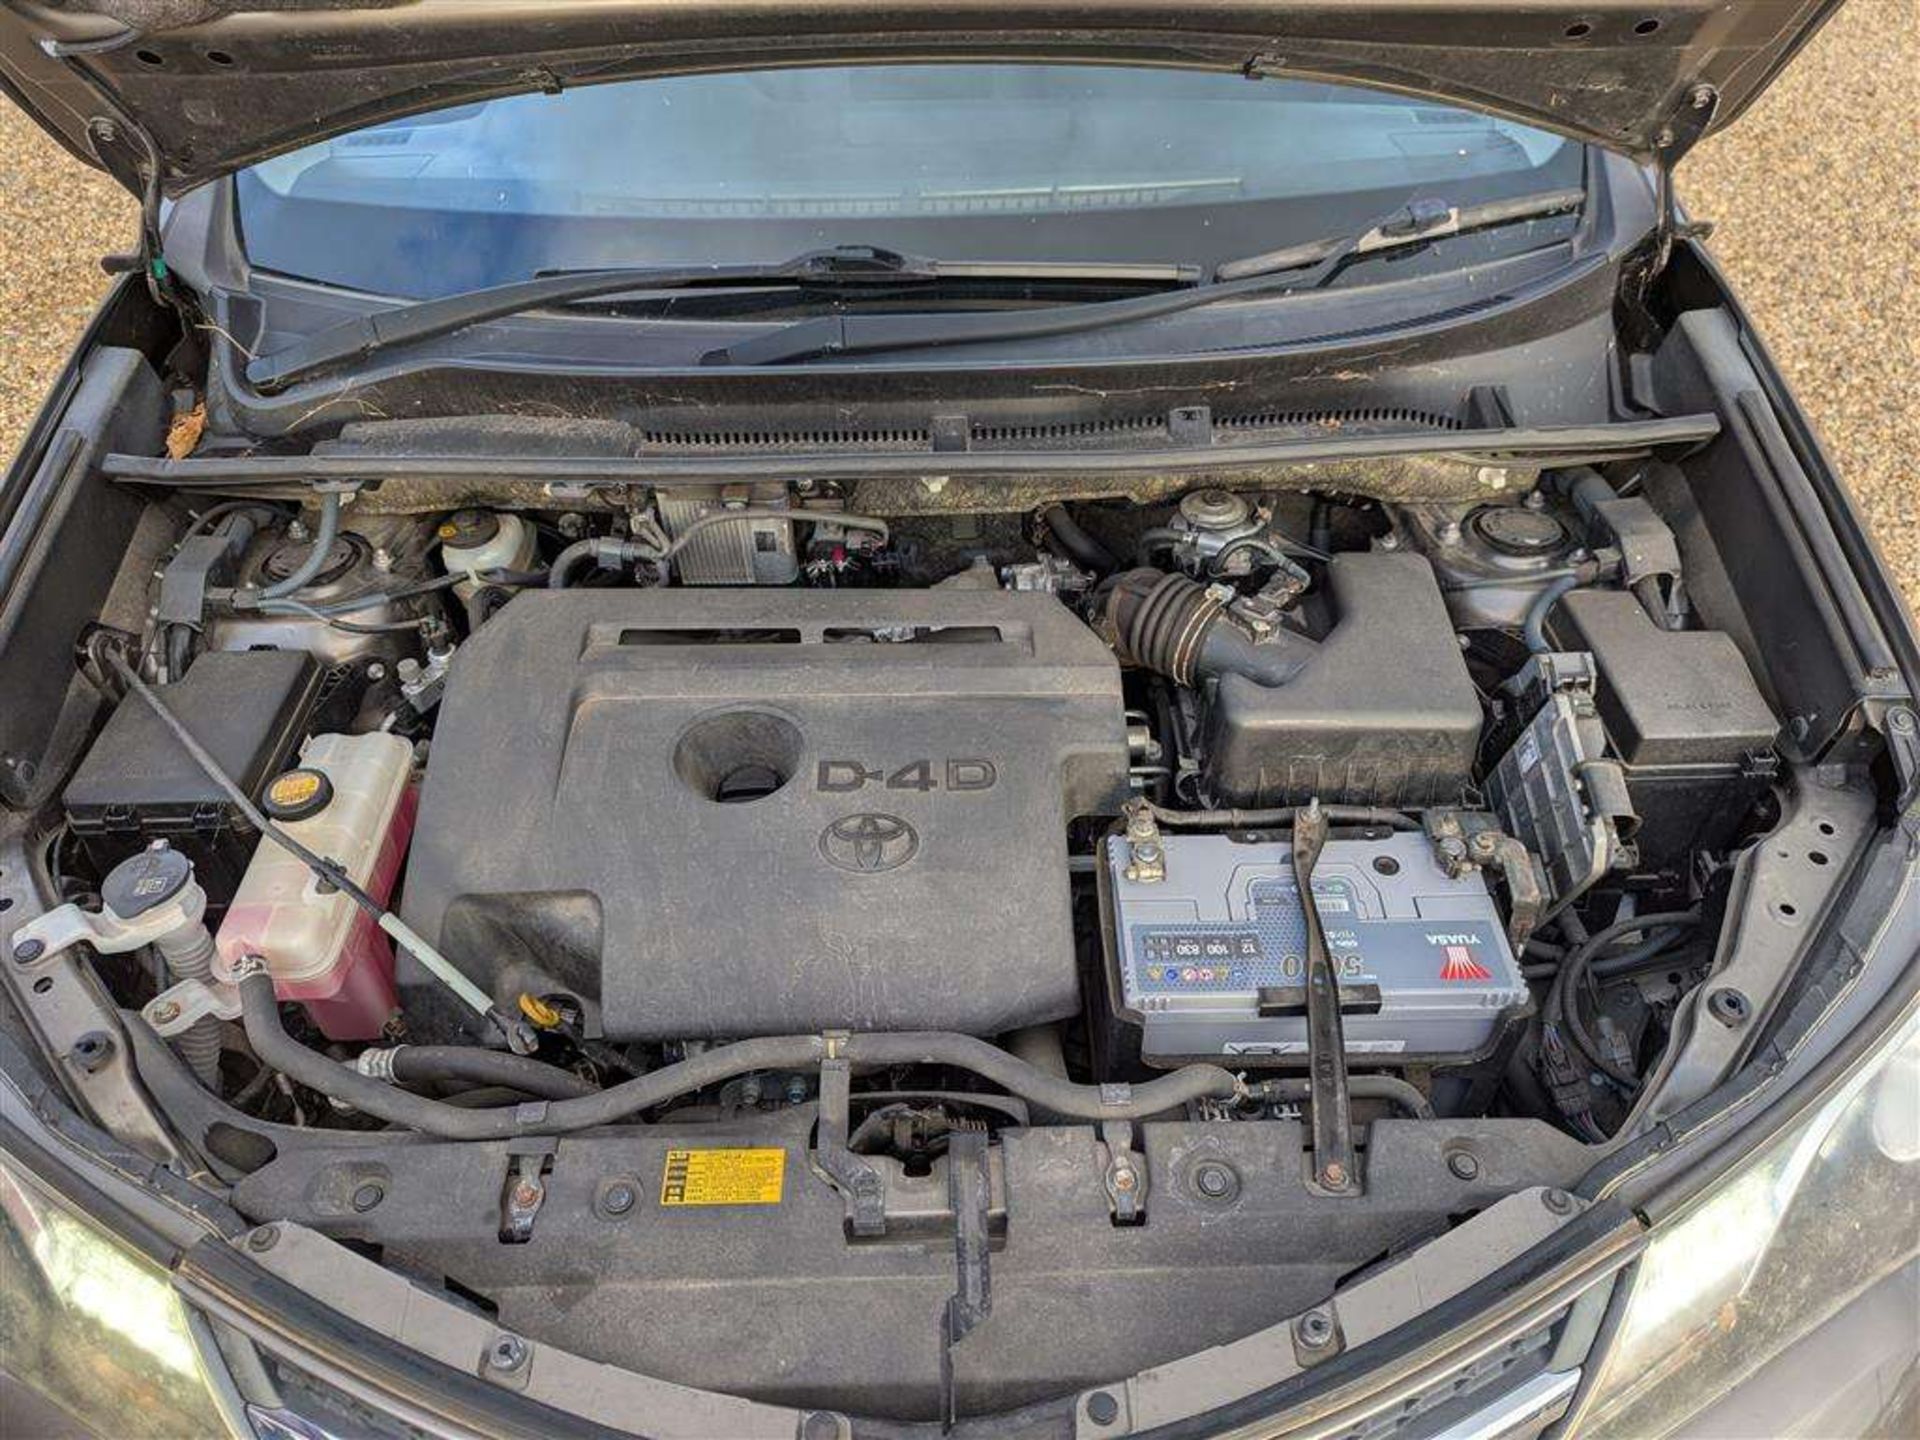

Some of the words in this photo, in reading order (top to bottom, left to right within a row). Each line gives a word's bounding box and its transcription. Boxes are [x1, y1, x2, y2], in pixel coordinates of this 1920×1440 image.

[817, 759, 997, 792] D-4D
[1425, 933, 1481, 945] YUASA
[1176, 944, 1199, 956] 830
[1207, 944, 1229, 955] 100
[1242, 944, 1256, 954] 12
